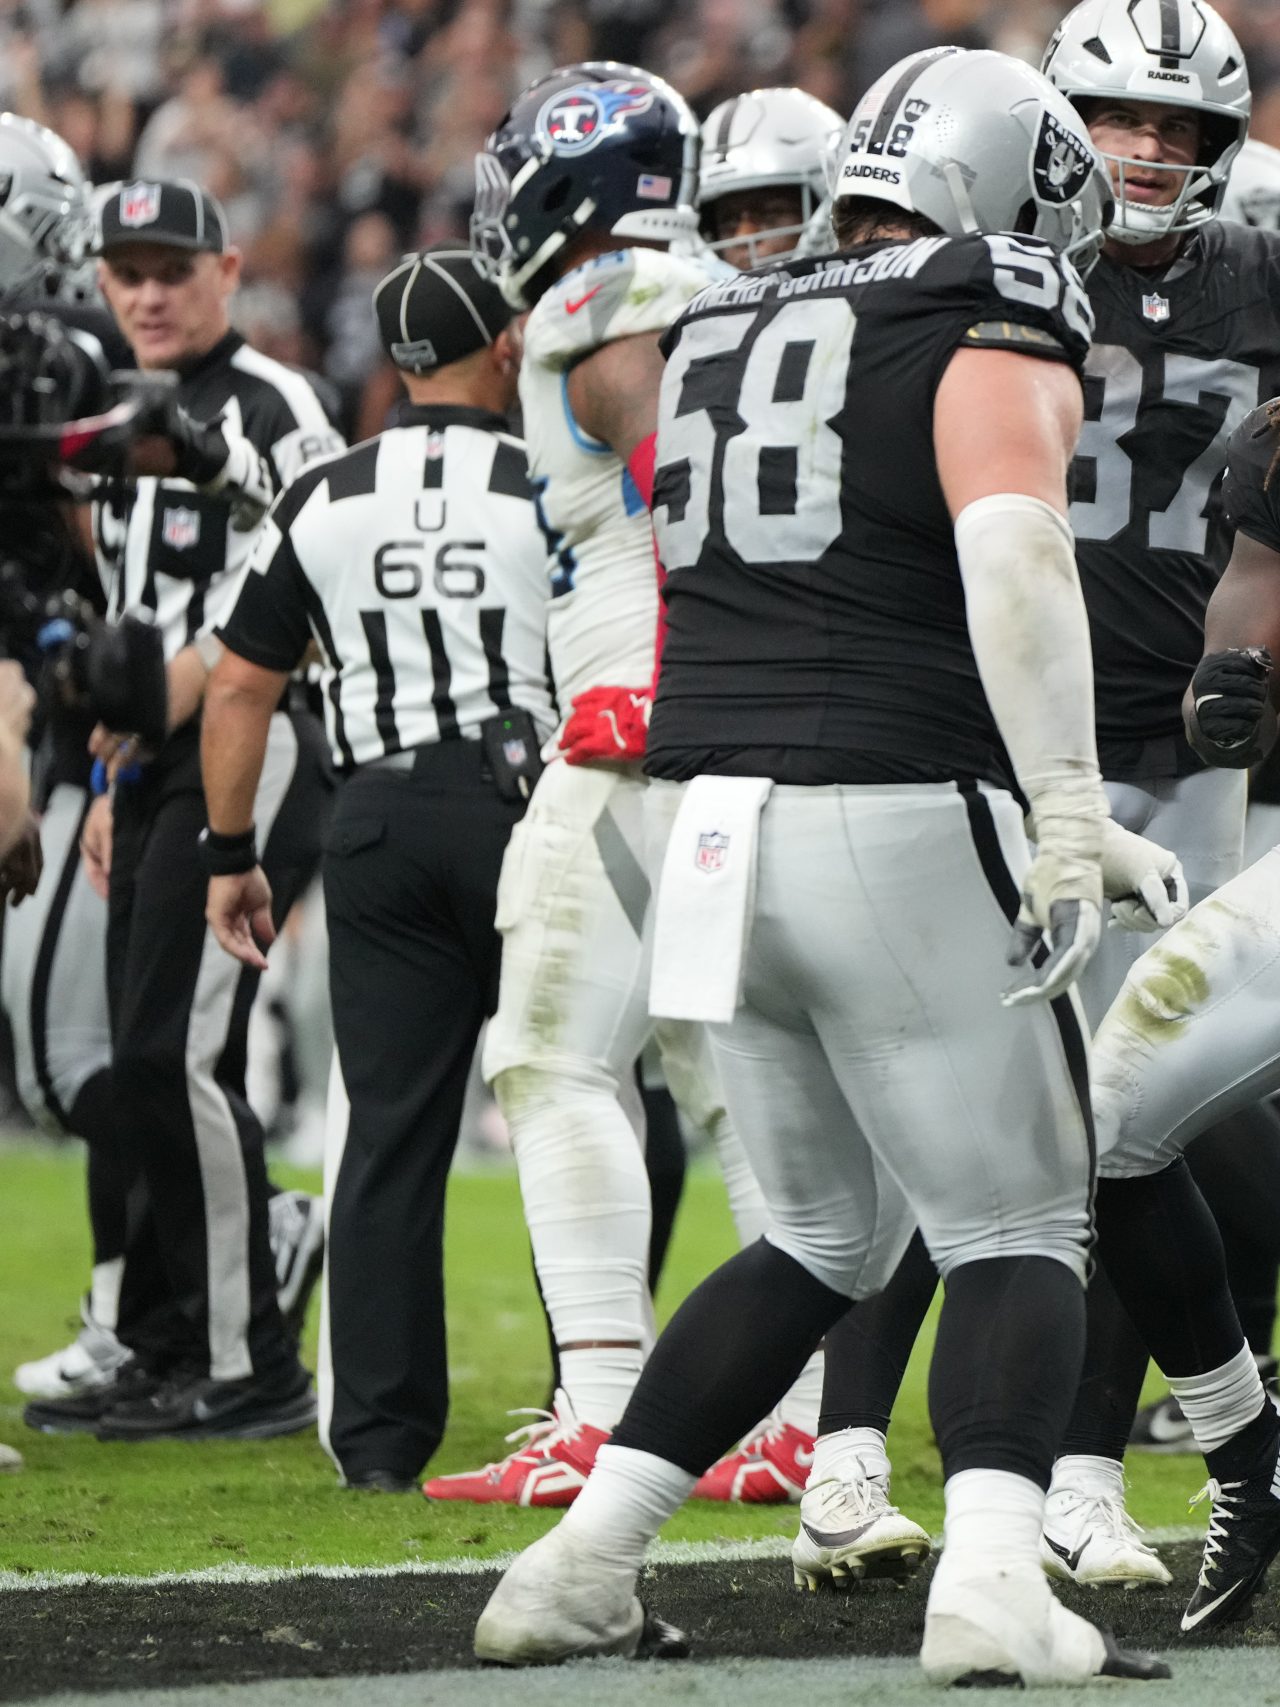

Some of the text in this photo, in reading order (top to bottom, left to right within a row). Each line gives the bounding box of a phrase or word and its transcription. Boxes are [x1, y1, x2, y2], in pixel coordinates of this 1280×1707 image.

[1147, 70, 1190, 84] RAIDERS
[1047, 116, 1092, 164] RAIDERS
[843, 164, 901, 185] RAIDERS
[652, 297, 858, 573] 58
[415, 499, 446, 532] U
[373, 540, 487, 600] 66
